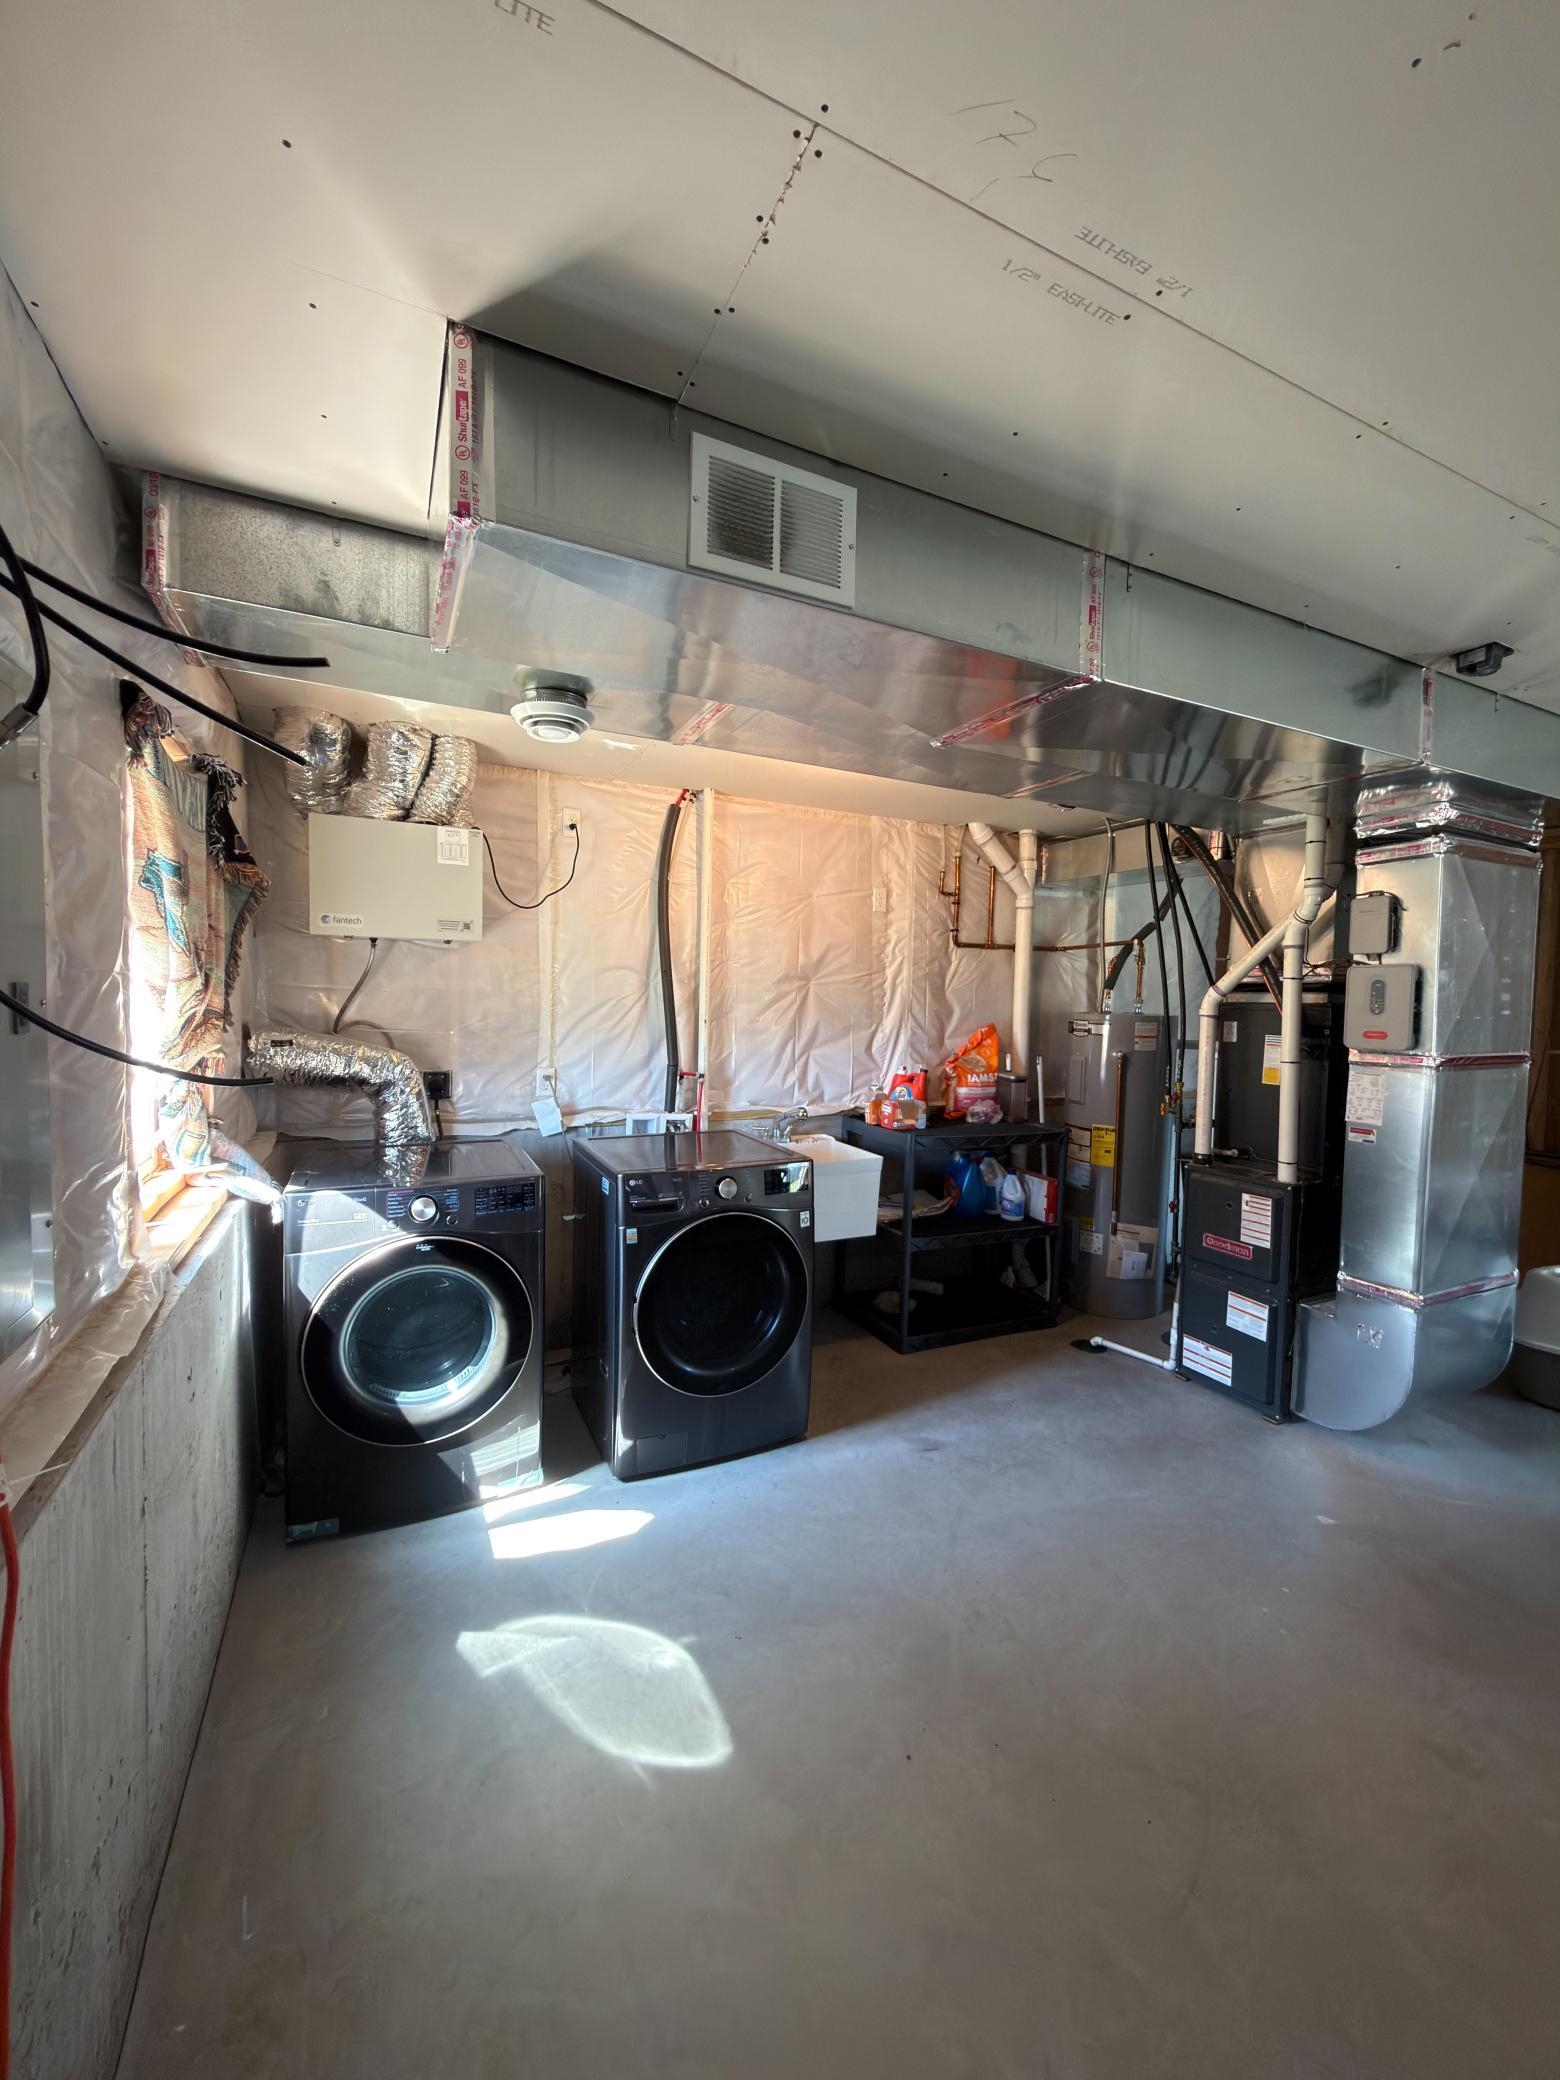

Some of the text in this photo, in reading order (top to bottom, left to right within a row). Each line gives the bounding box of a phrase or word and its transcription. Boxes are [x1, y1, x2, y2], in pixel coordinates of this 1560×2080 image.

[457, 358, 467, 373] 099
[457, 375, 467, 389] AF
[460, 469, 469, 500] AF 099
[333, 915, 362, 925] fantech
[967, 1073, 994, 1083] IAMS
[1206, 1236, 1250, 1257] Goodman
